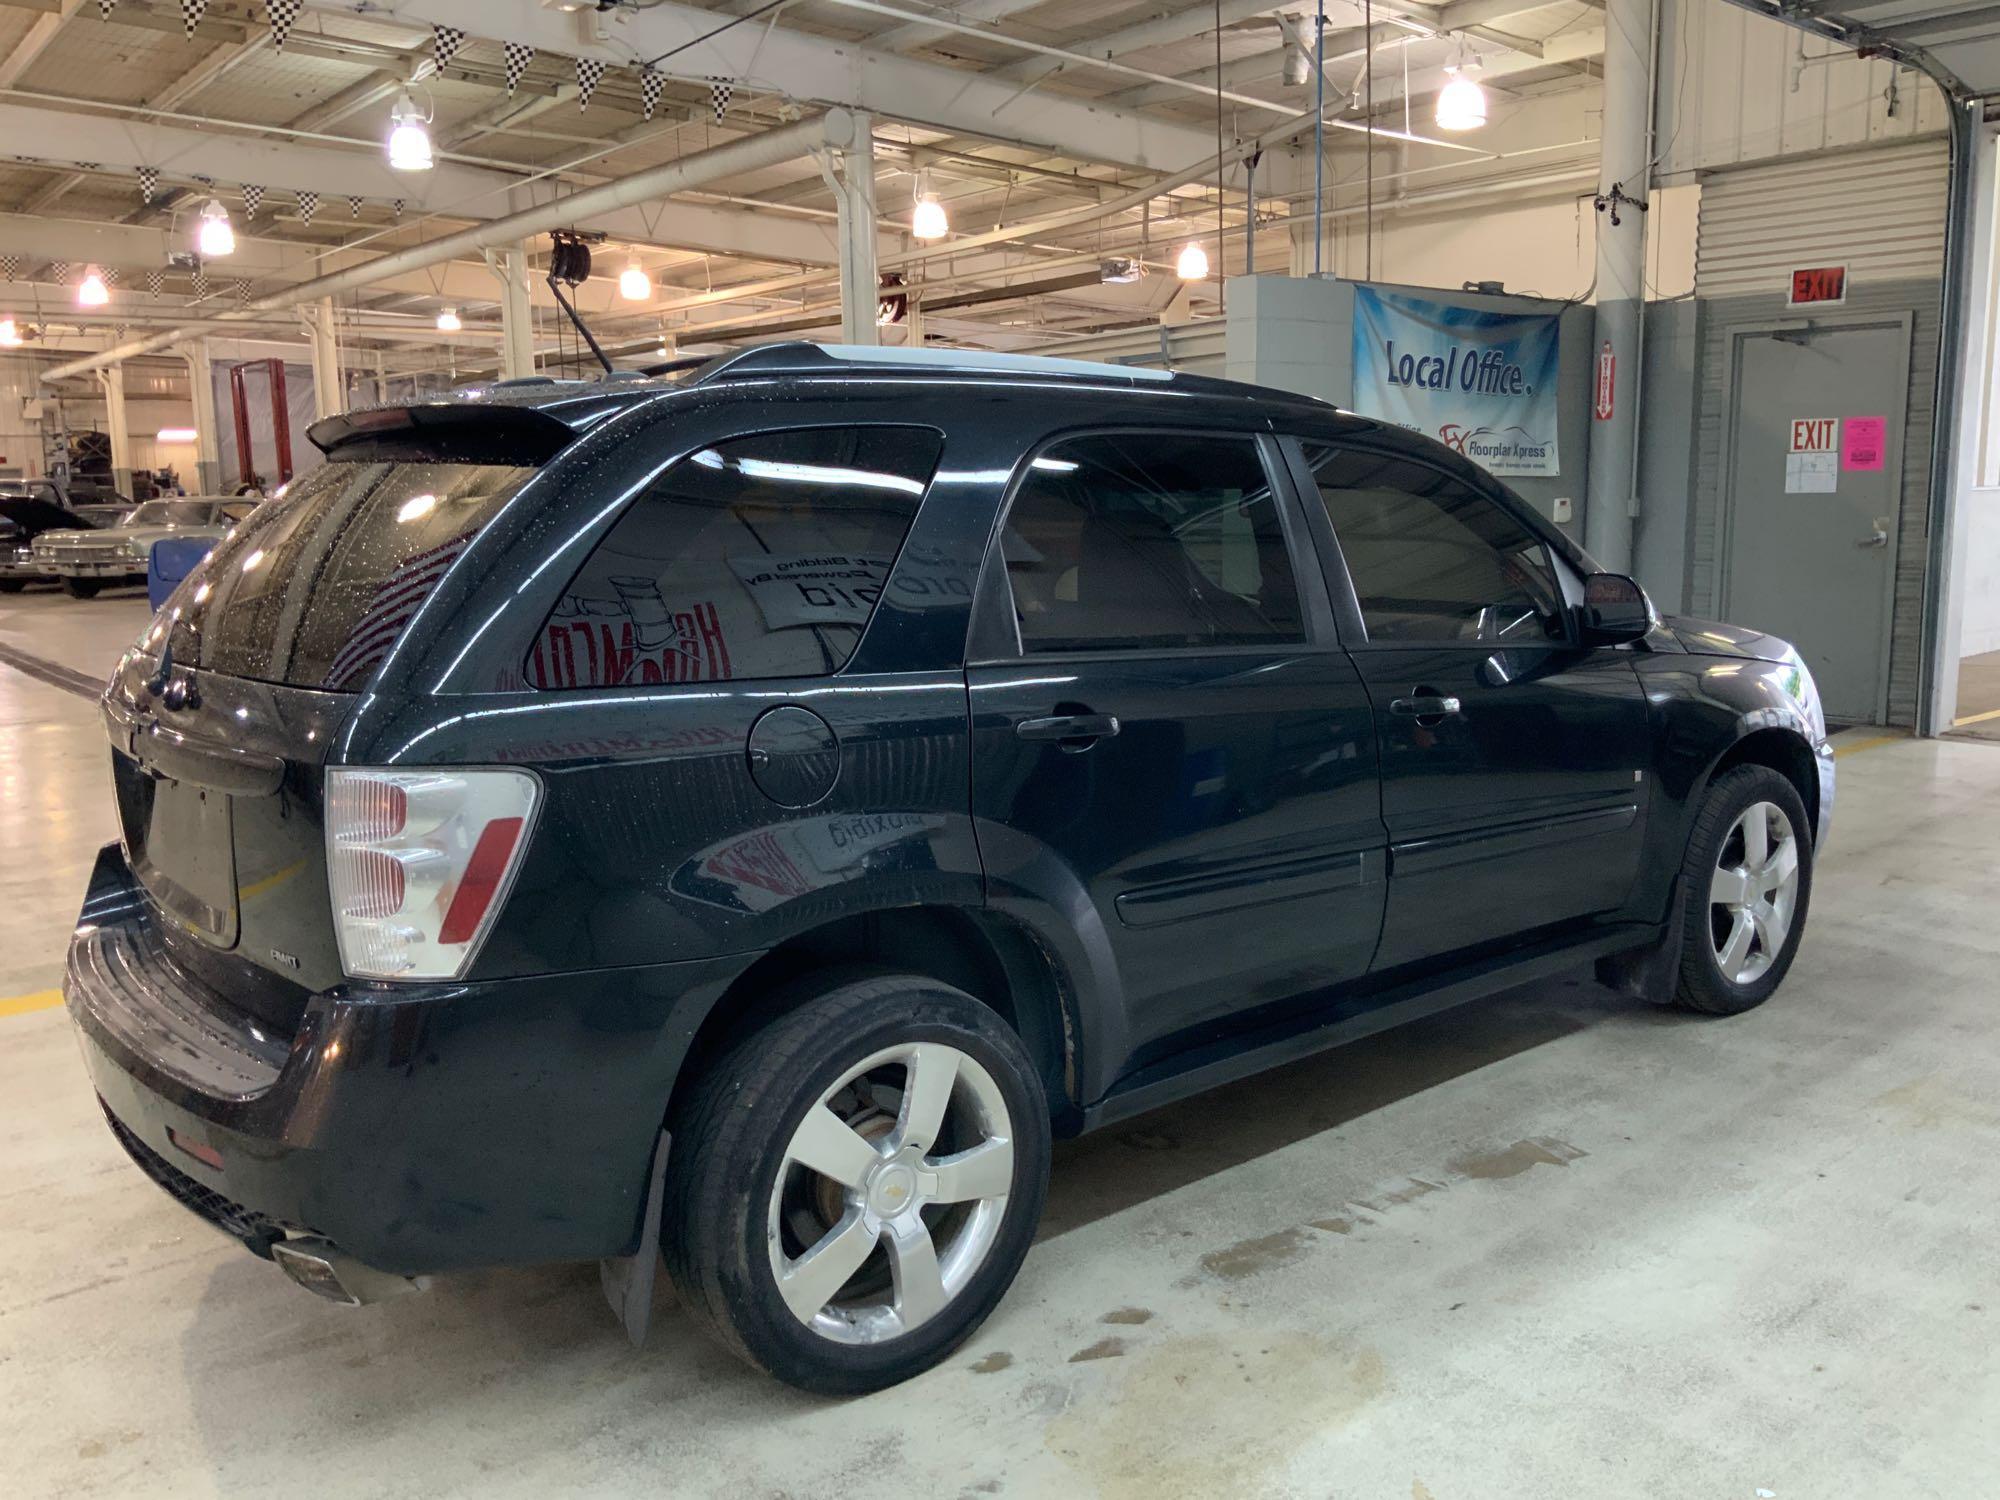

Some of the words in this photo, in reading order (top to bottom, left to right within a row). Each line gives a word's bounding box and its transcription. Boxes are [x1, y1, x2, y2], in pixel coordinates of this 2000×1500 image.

[1796, 270, 1839, 299] EXIT
[1387, 340, 1456, 390] Local
[1460, 349, 1533, 396] Office.
[1794, 420, 1835, 450] EXIT
[1511, 443, 1546, 460] Xpress
